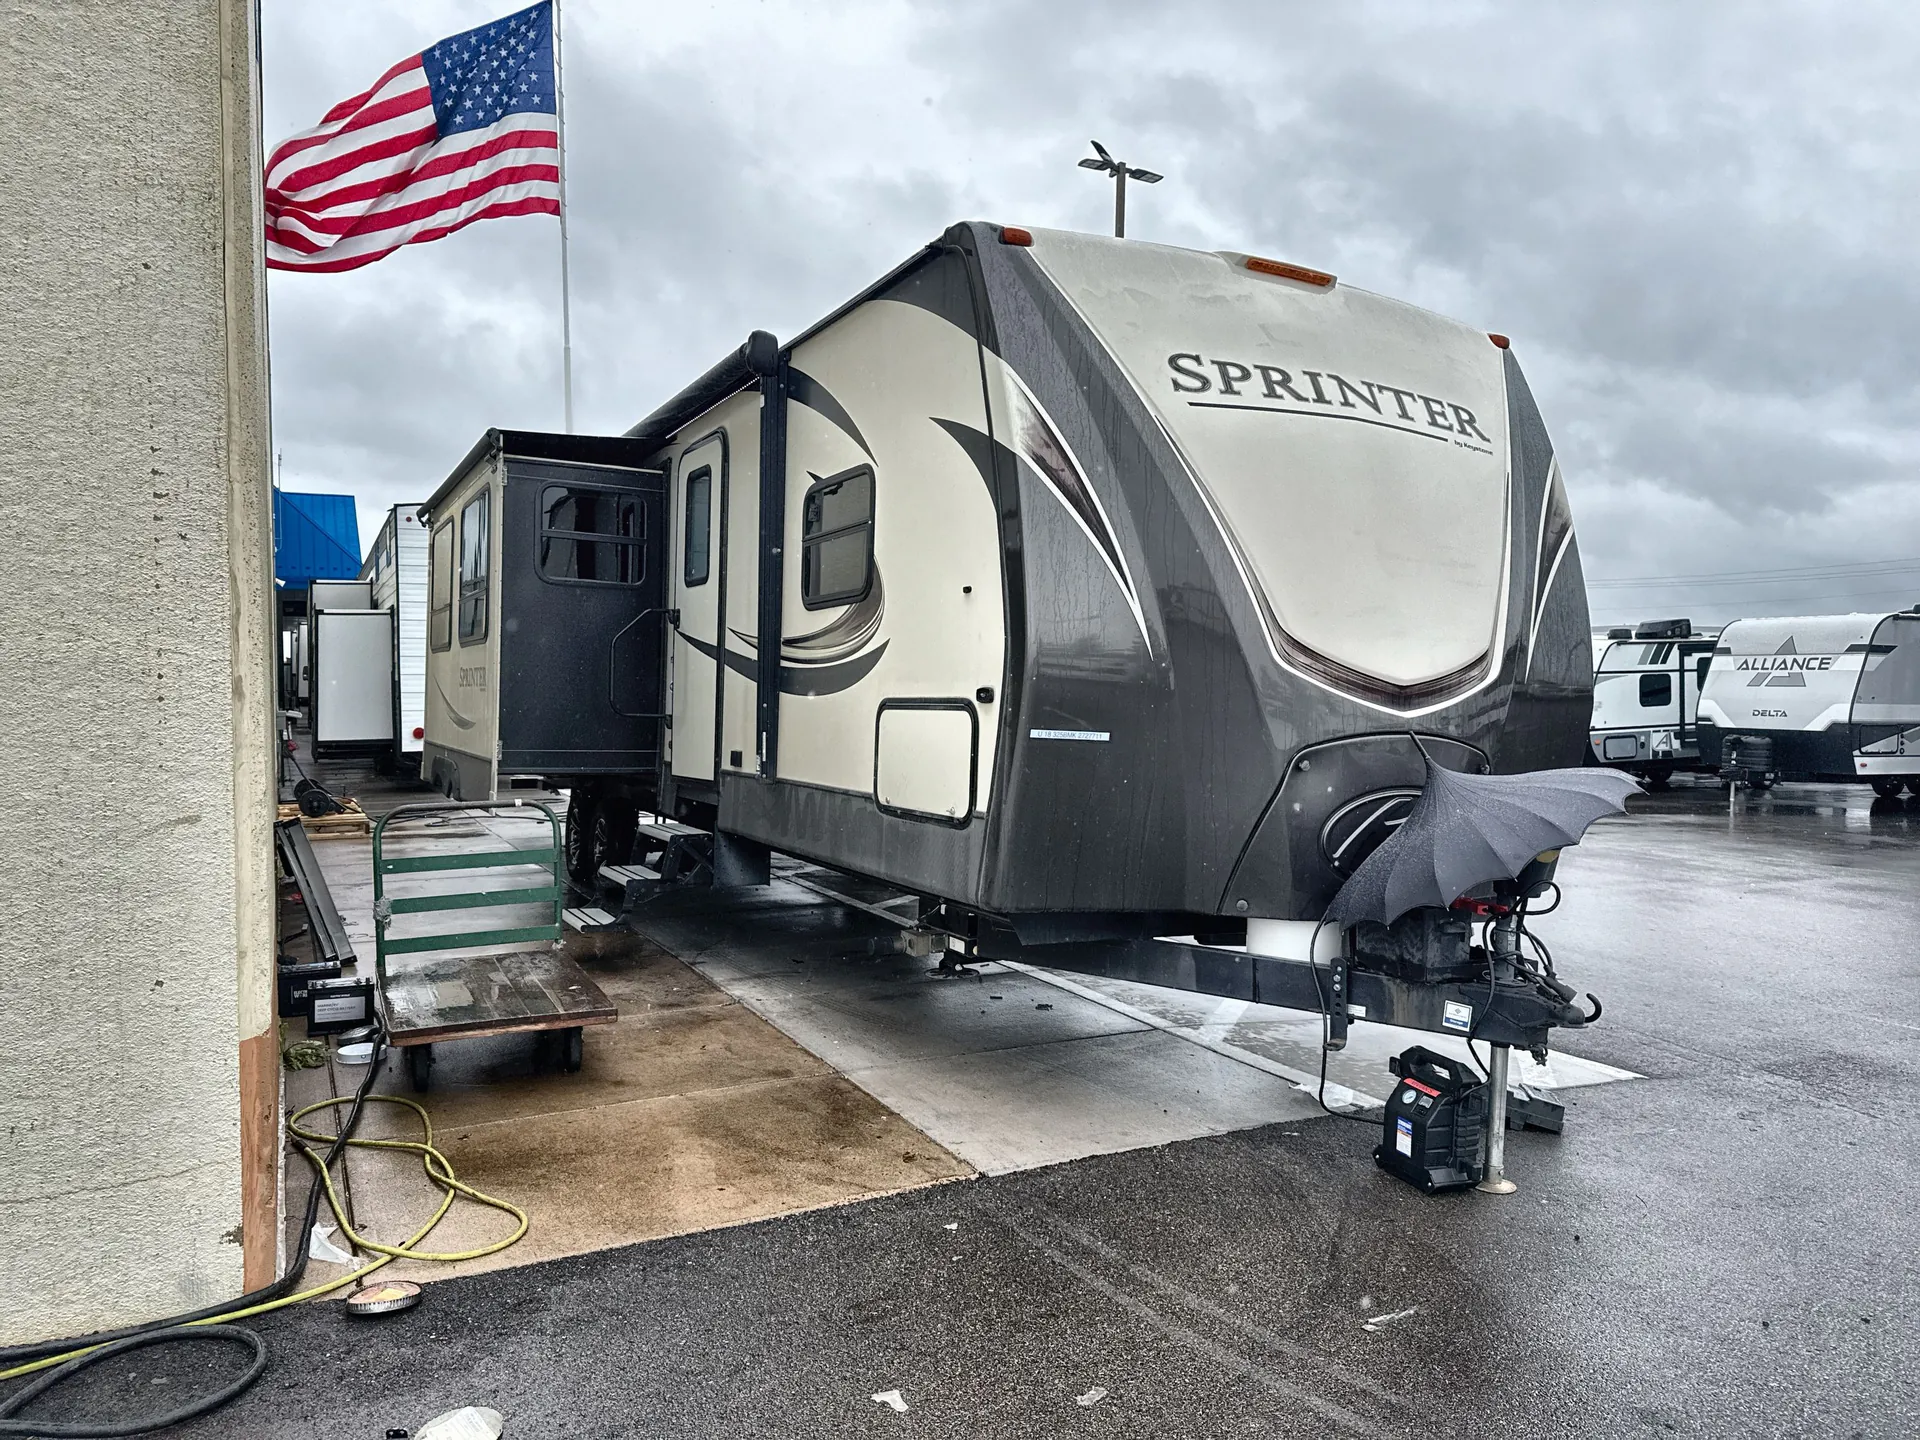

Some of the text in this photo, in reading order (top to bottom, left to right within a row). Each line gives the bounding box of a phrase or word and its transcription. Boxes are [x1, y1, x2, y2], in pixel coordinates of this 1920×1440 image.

[1167, 352, 1492, 444] SPRINTER
[1736, 657, 1832, 671] ALLIANCE
[459, 666, 487, 687] SPRINTER
[1752, 709, 1788, 717] DELTA
